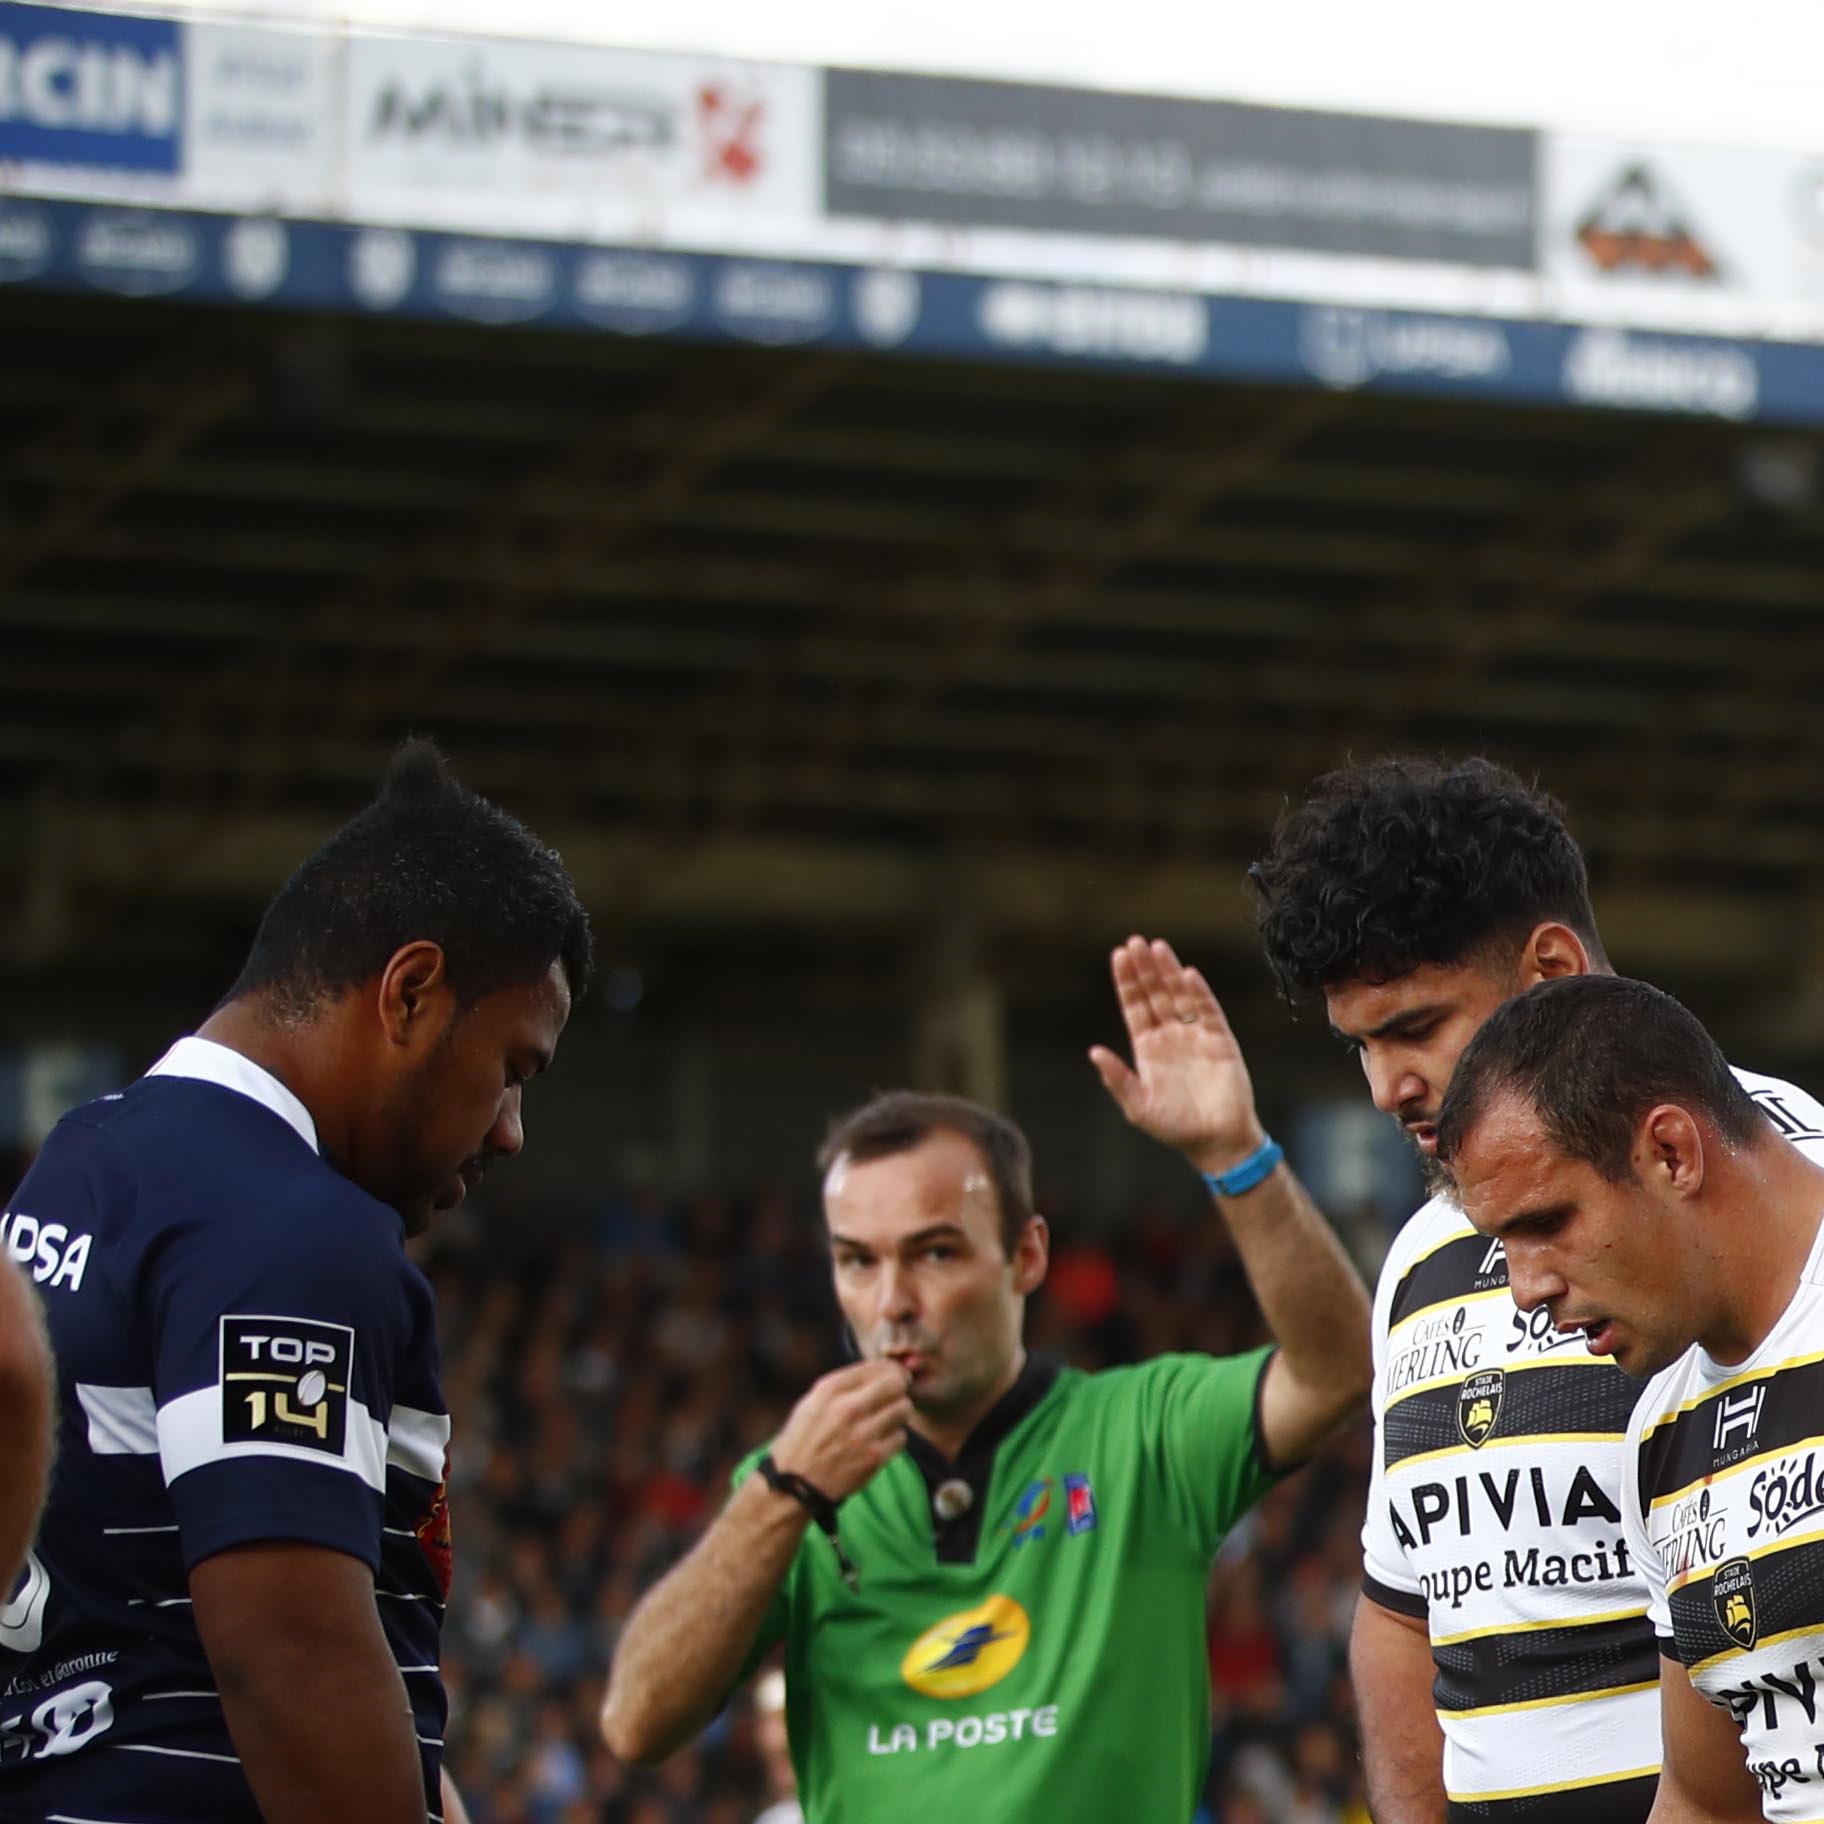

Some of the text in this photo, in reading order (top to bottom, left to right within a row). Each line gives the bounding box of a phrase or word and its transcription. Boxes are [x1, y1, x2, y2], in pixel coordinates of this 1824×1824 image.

[239, 1335, 336, 1366] TOP
[244, 1391, 328, 1440] 14
[1388, 1465, 1622, 1550] APIVIA
[1503, 1538, 1636, 1588] Macif
[867, 1705, 1060, 1755] LA POSTE
